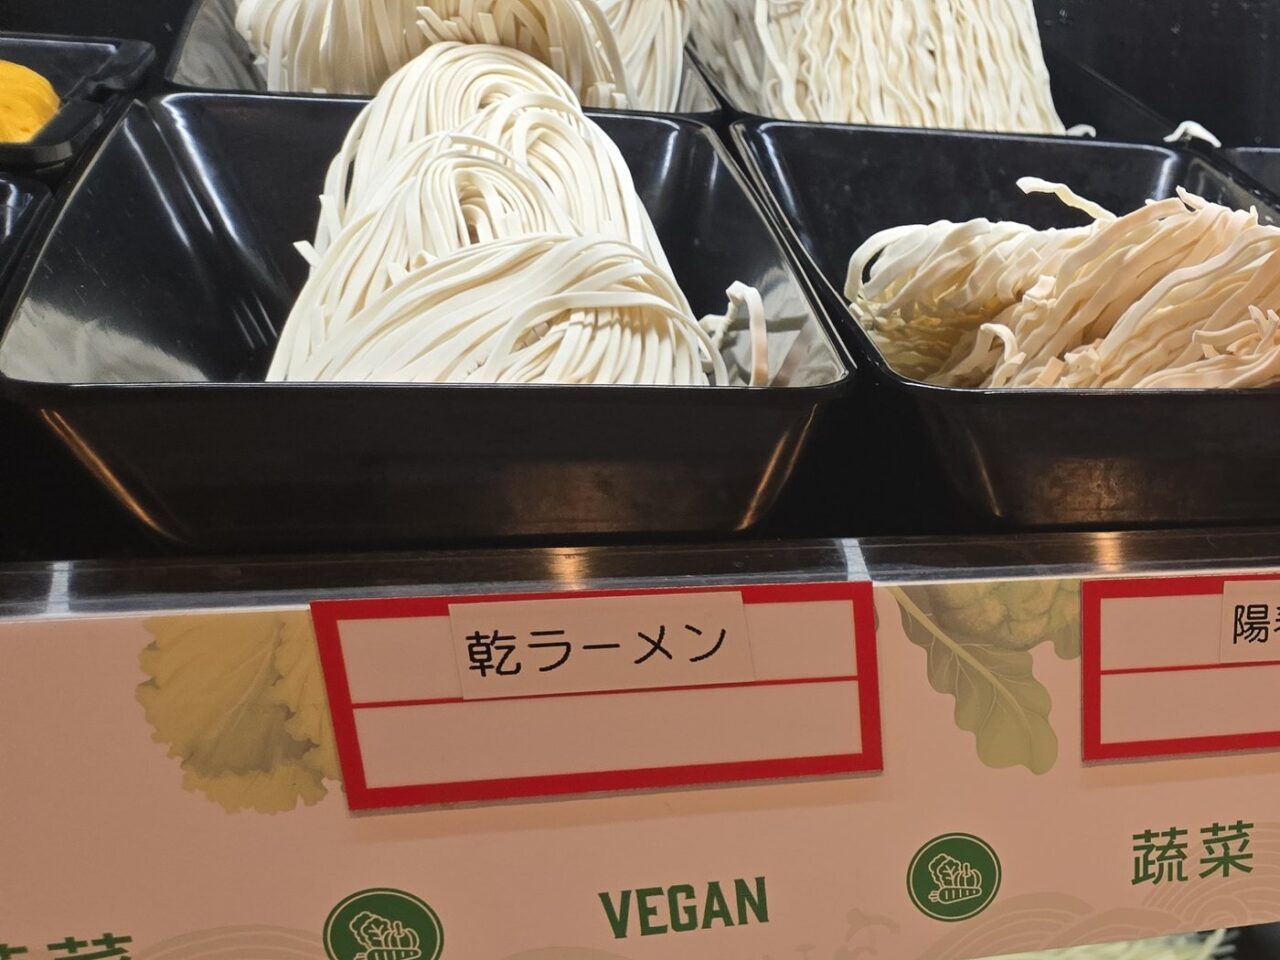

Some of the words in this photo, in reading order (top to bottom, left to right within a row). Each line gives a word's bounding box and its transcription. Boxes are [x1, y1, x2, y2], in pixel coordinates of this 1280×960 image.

[465, 624, 726, 677] 乾ラーメン
[1131, 819, 1254, 885] 蔬菜
[597, 876, 769, 939] VEGAN
